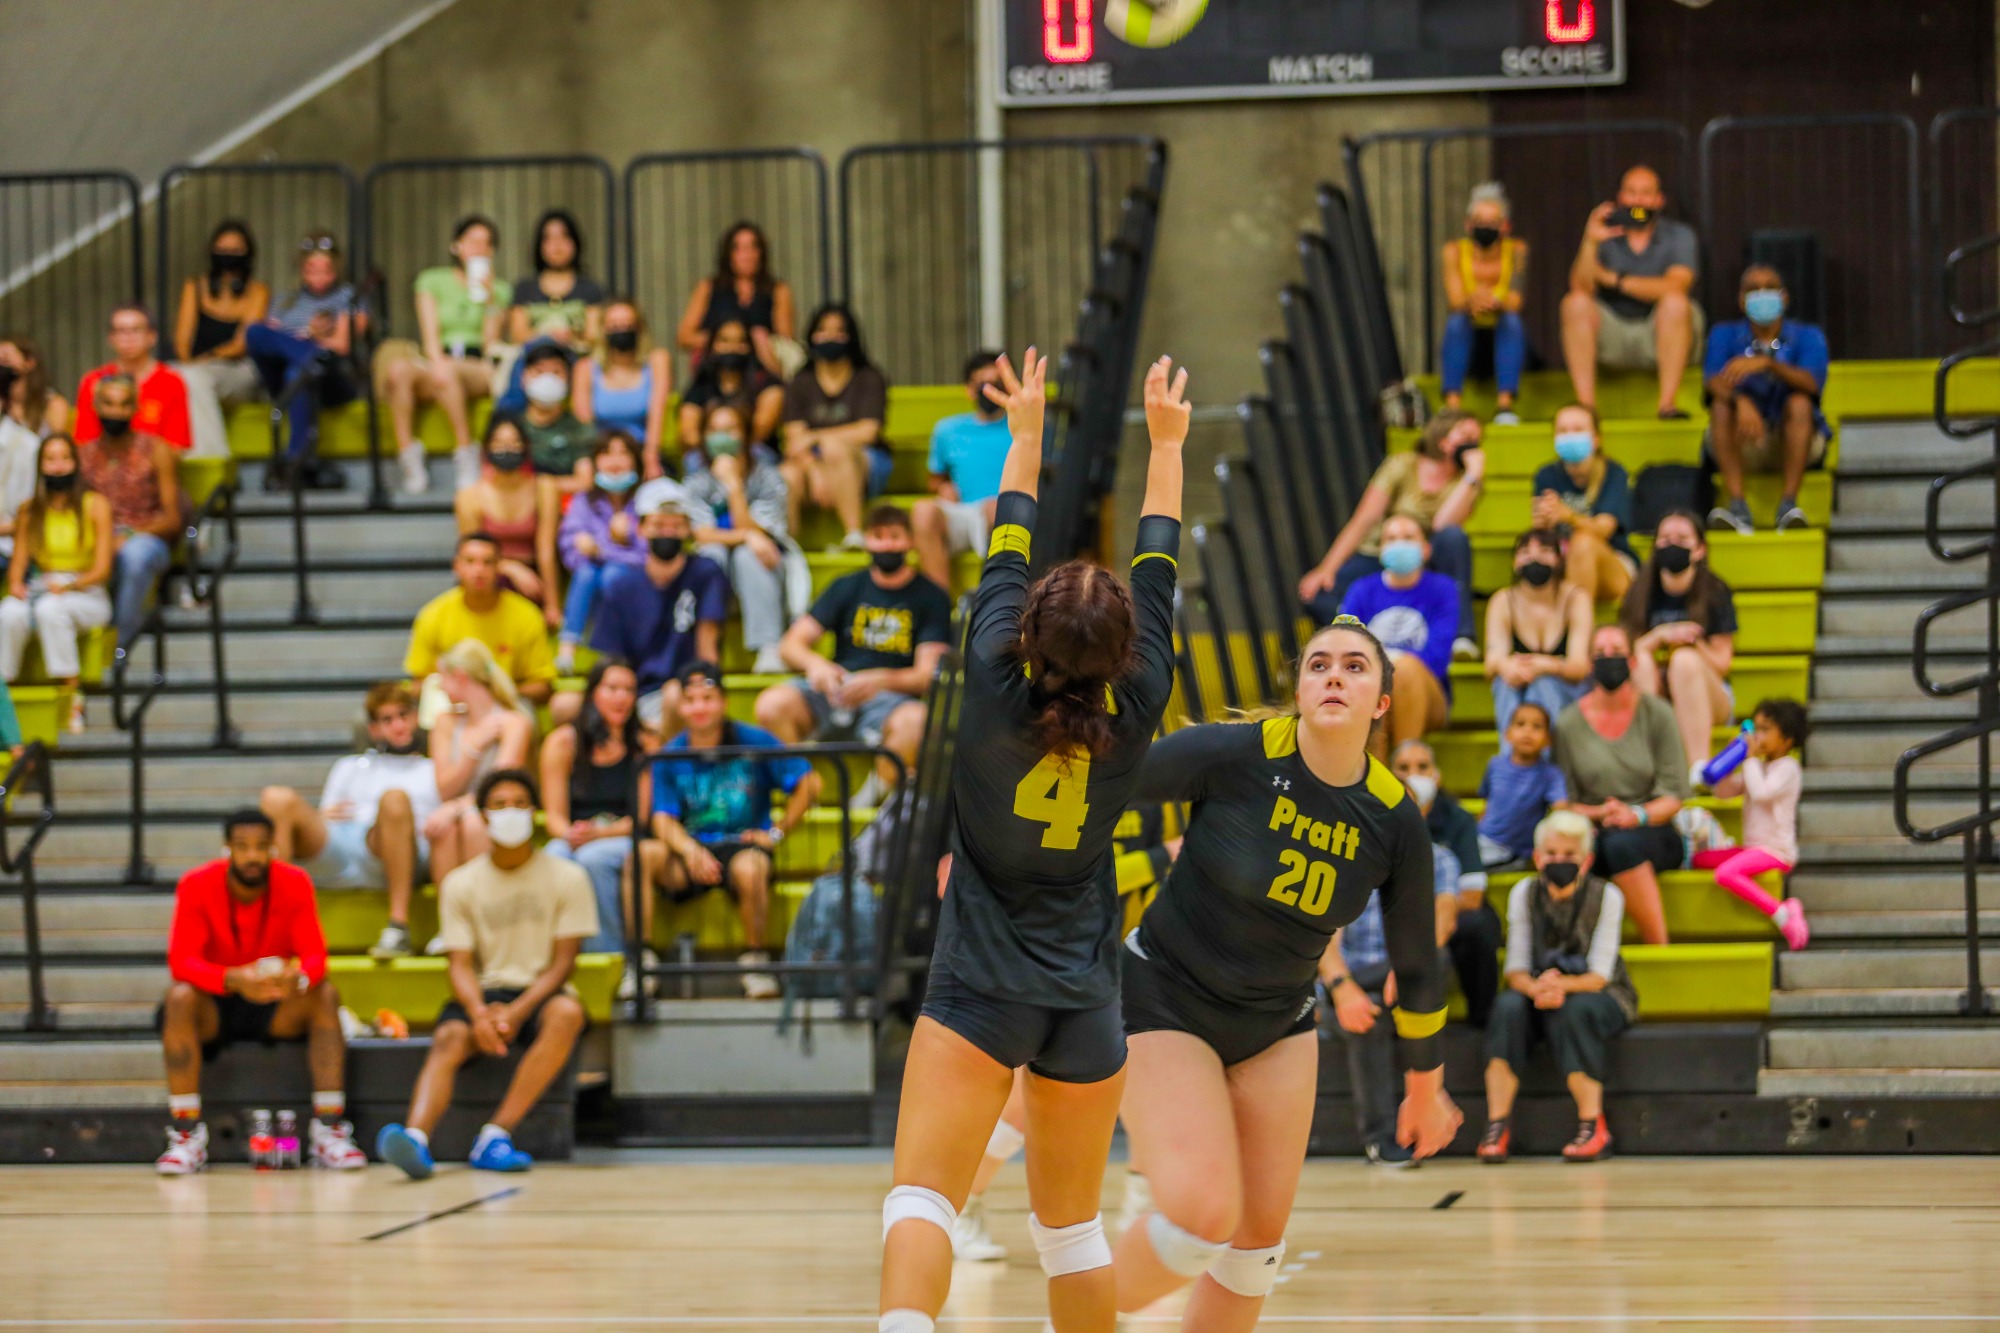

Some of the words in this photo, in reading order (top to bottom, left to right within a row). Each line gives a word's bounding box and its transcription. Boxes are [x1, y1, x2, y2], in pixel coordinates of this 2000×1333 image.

[1008, 62, 1112, 94] SCORE
[1268, 54, 1373, 83] MATCH
[1501, 43, 1606, 77] SCORE
[1013, 743, 1091, 850] 4
[1268, 795, 1360, 861] Pratt
[1266, 848, 1337, 916] 20
